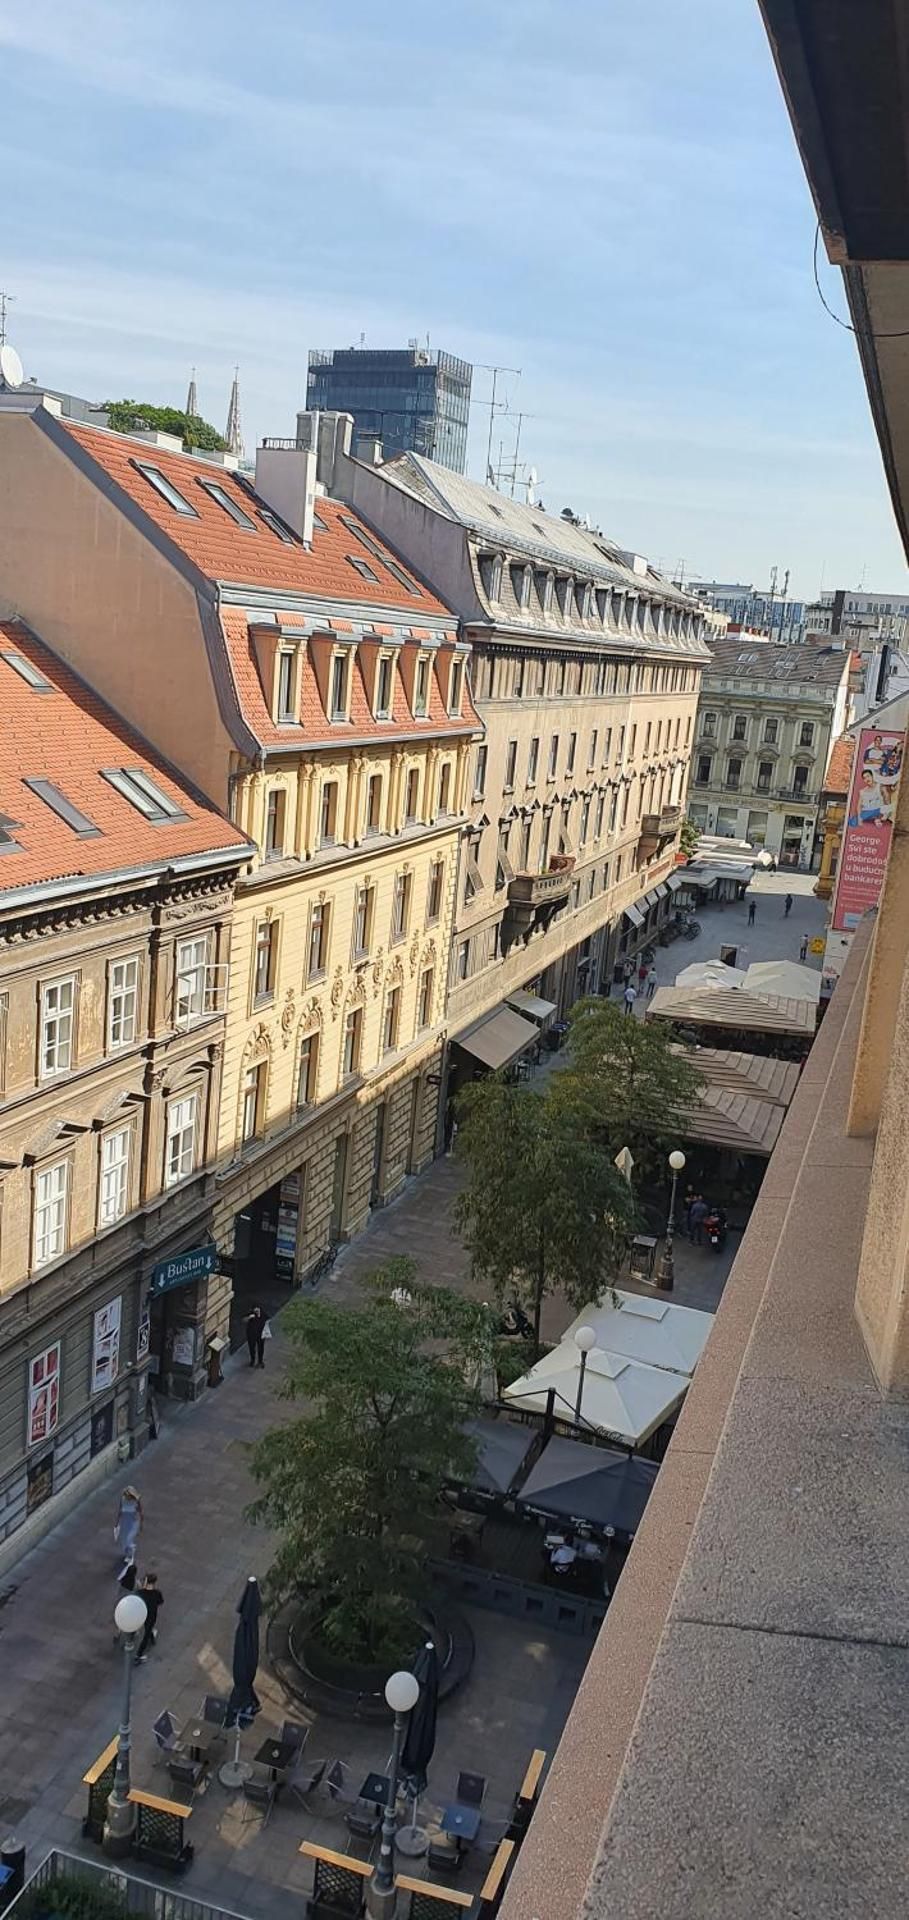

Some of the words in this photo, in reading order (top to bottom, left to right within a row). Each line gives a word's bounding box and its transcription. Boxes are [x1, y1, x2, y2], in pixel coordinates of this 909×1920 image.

[863, 846, 877, 855] ste
[845, 864, 851, 872] u
[167, 1256, 205, 1278] Bustan
